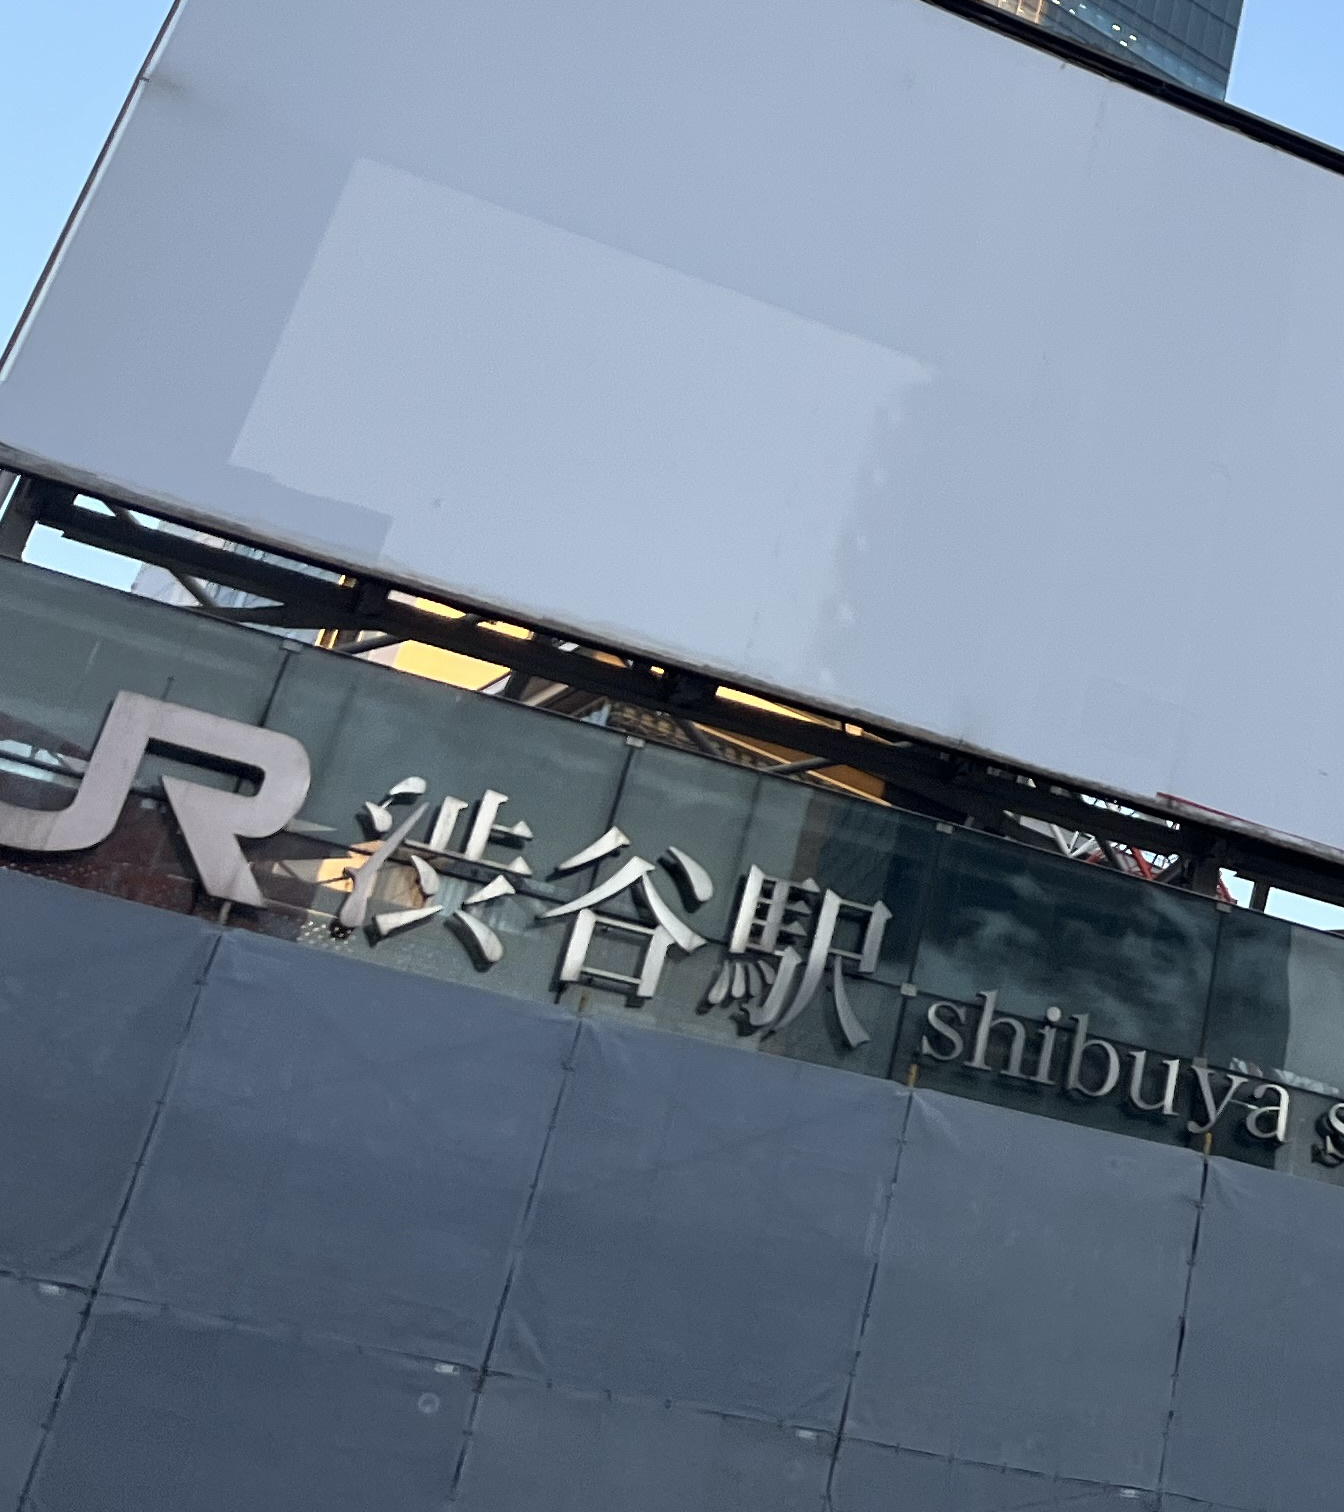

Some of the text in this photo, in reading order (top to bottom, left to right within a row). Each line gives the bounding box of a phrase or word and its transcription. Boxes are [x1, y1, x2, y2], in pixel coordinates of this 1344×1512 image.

[0, 691, 892, 1048] JR 渋谷駅
[921, 990, 1291, 1145] shibuya
